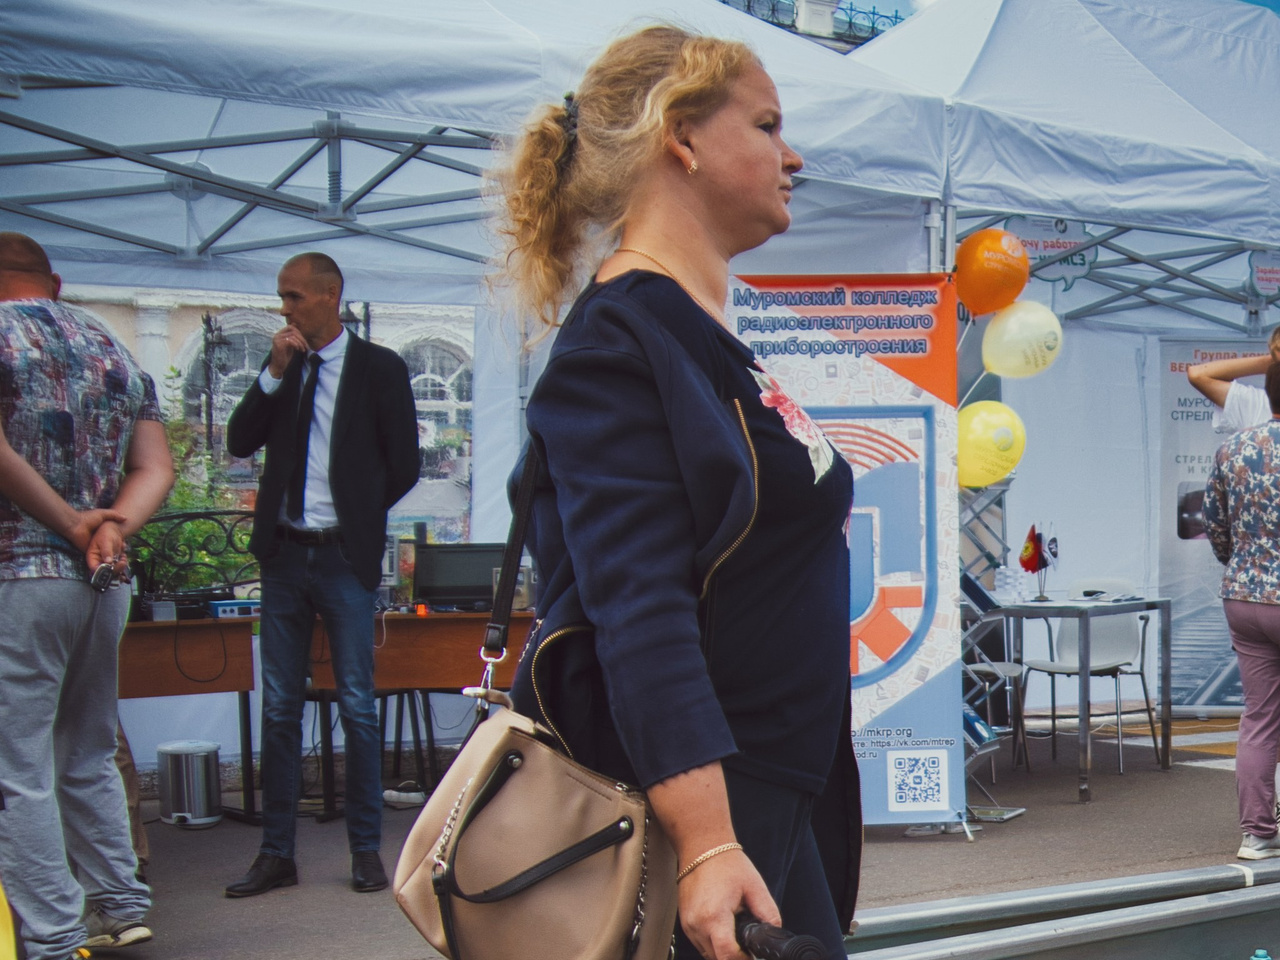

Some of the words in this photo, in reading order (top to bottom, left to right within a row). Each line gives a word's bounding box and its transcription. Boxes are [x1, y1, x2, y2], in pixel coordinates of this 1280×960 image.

[1018, 237, 1039, 251] очу
[733, 287, 846, 310] Муромский
[851, 289, 938, 308] колледж
[737, 315, 934, 335] радиоэлектронного
[750, 337, 927, 358] приборостроения
[1194, 349, 1238, 362] Группа
[1177, 398, 1216, 408] МУРО
